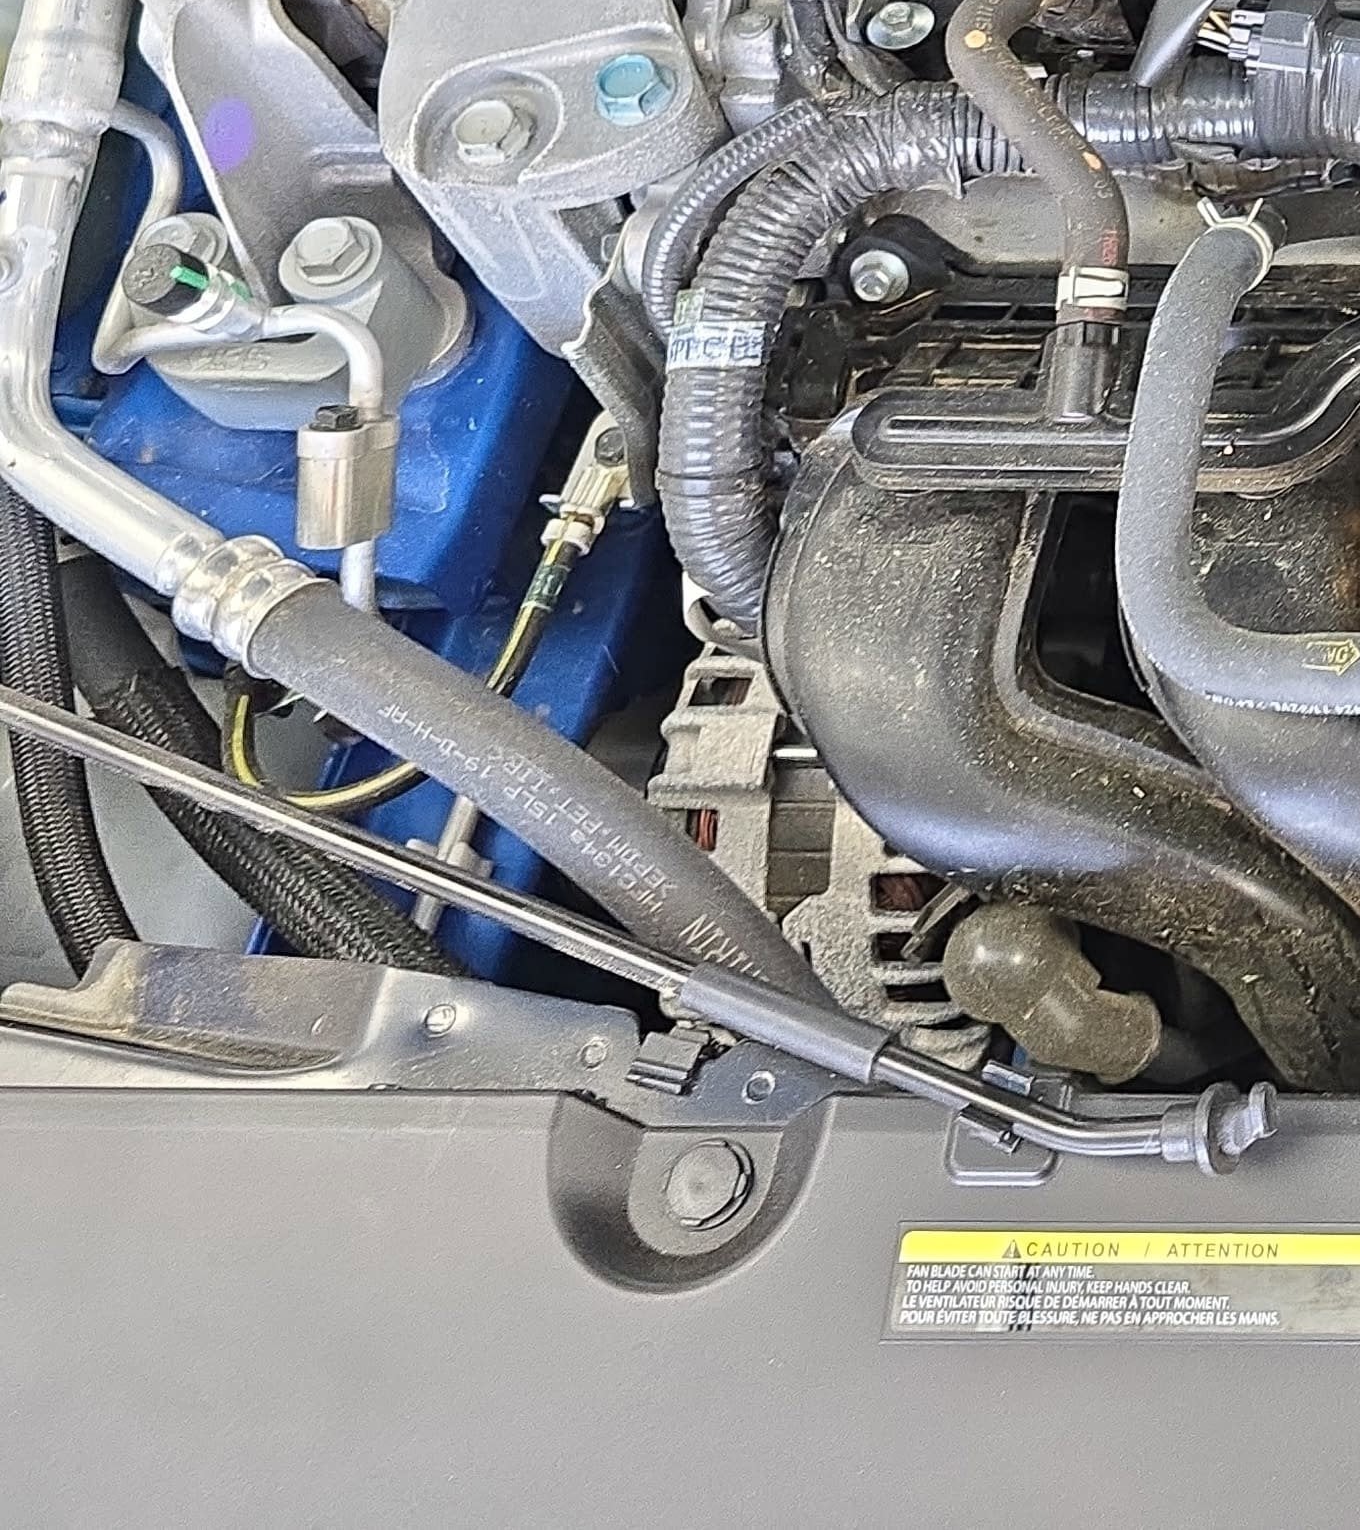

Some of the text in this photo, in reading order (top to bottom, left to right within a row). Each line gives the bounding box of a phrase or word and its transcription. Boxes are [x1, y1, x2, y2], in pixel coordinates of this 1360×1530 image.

[1026, 1241, 1120, 1258] CAUTION
[1166, 1242, 1279, 1259] ATTENTION
[907, 1265, 1095, 1279] FAN BLADE CAN START AT ANY TIME.
[907, 1280, 1191, 1296] TO HELP AVOID PERSONAL INJURY, KEEP HANDS CLEAR.
[902, 1295, 918, 1308] LE
[919, 1295, 998, 1308] VENTILATEUR
[999, 1295, 1040, 1309] RISQUE
[1043, 1295, 1061, 1308] DE
[1062, 1293, 1127, 1309] DÉMARRER
[1140, 1296, 1174, 1309] TOUT
[1174, 1296, 1230, 1310] MOMENT.
[900, 1310, 935, 1324] POUR
[936, 1308, 977, 1324] ÉVITER
[978, 1311, 1017, 1324] TOUTE
[1080, 1311, 1097, 1324] NE
[1100, 1311, 1122, 1325] PAS
[1124, 1311, 1142, 1325] EN
[1143, 1311, 1214, 1325] APPROCHER
[1215, 1312, 1237, 1325] LES
[1238, 1312, 1280, 1326] MAINS.
